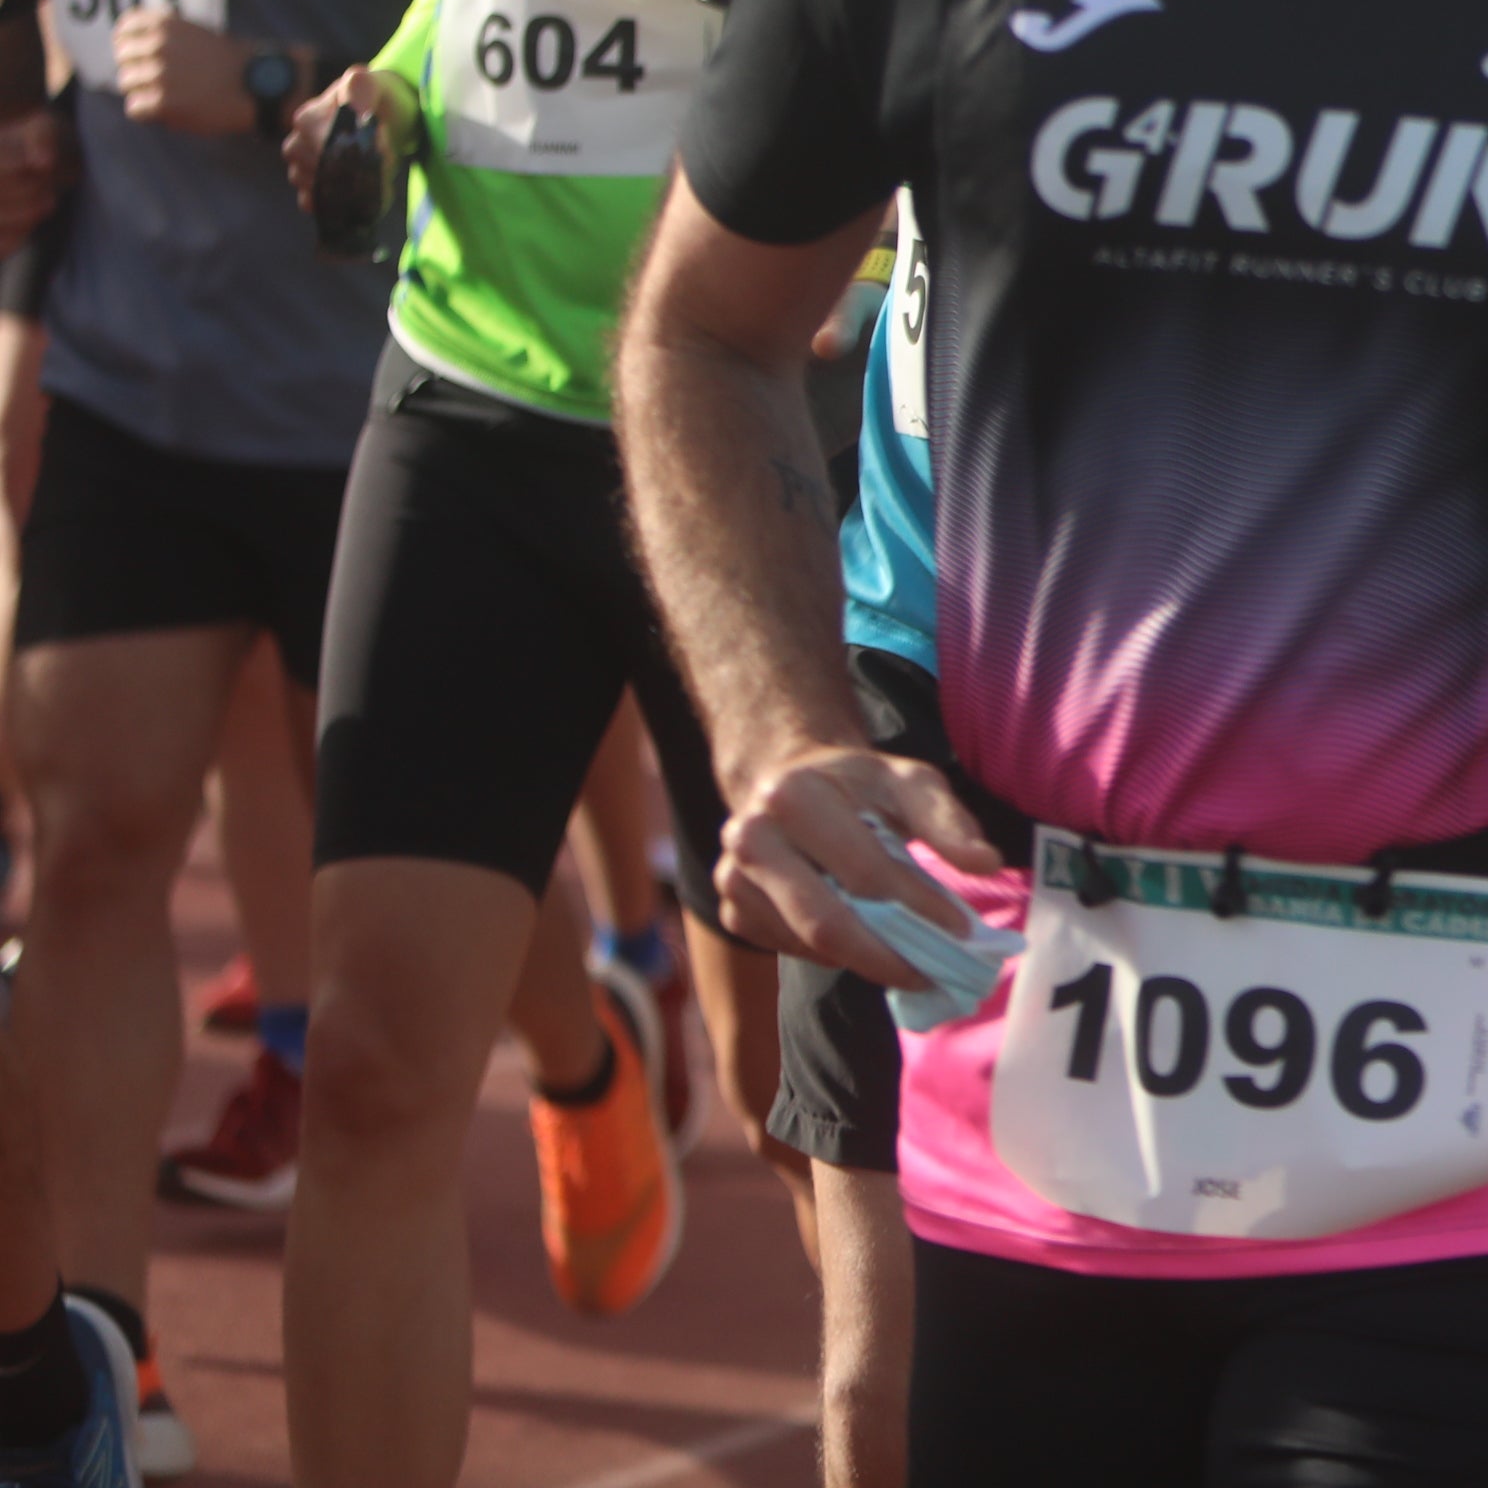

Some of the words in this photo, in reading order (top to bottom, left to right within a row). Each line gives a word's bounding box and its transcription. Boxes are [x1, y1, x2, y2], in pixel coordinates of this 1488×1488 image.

[475, 10, 644, 93] 604
[1402, 267, 1488, 304] CLUB
[1049, 962, 1428, 1122] 1096
